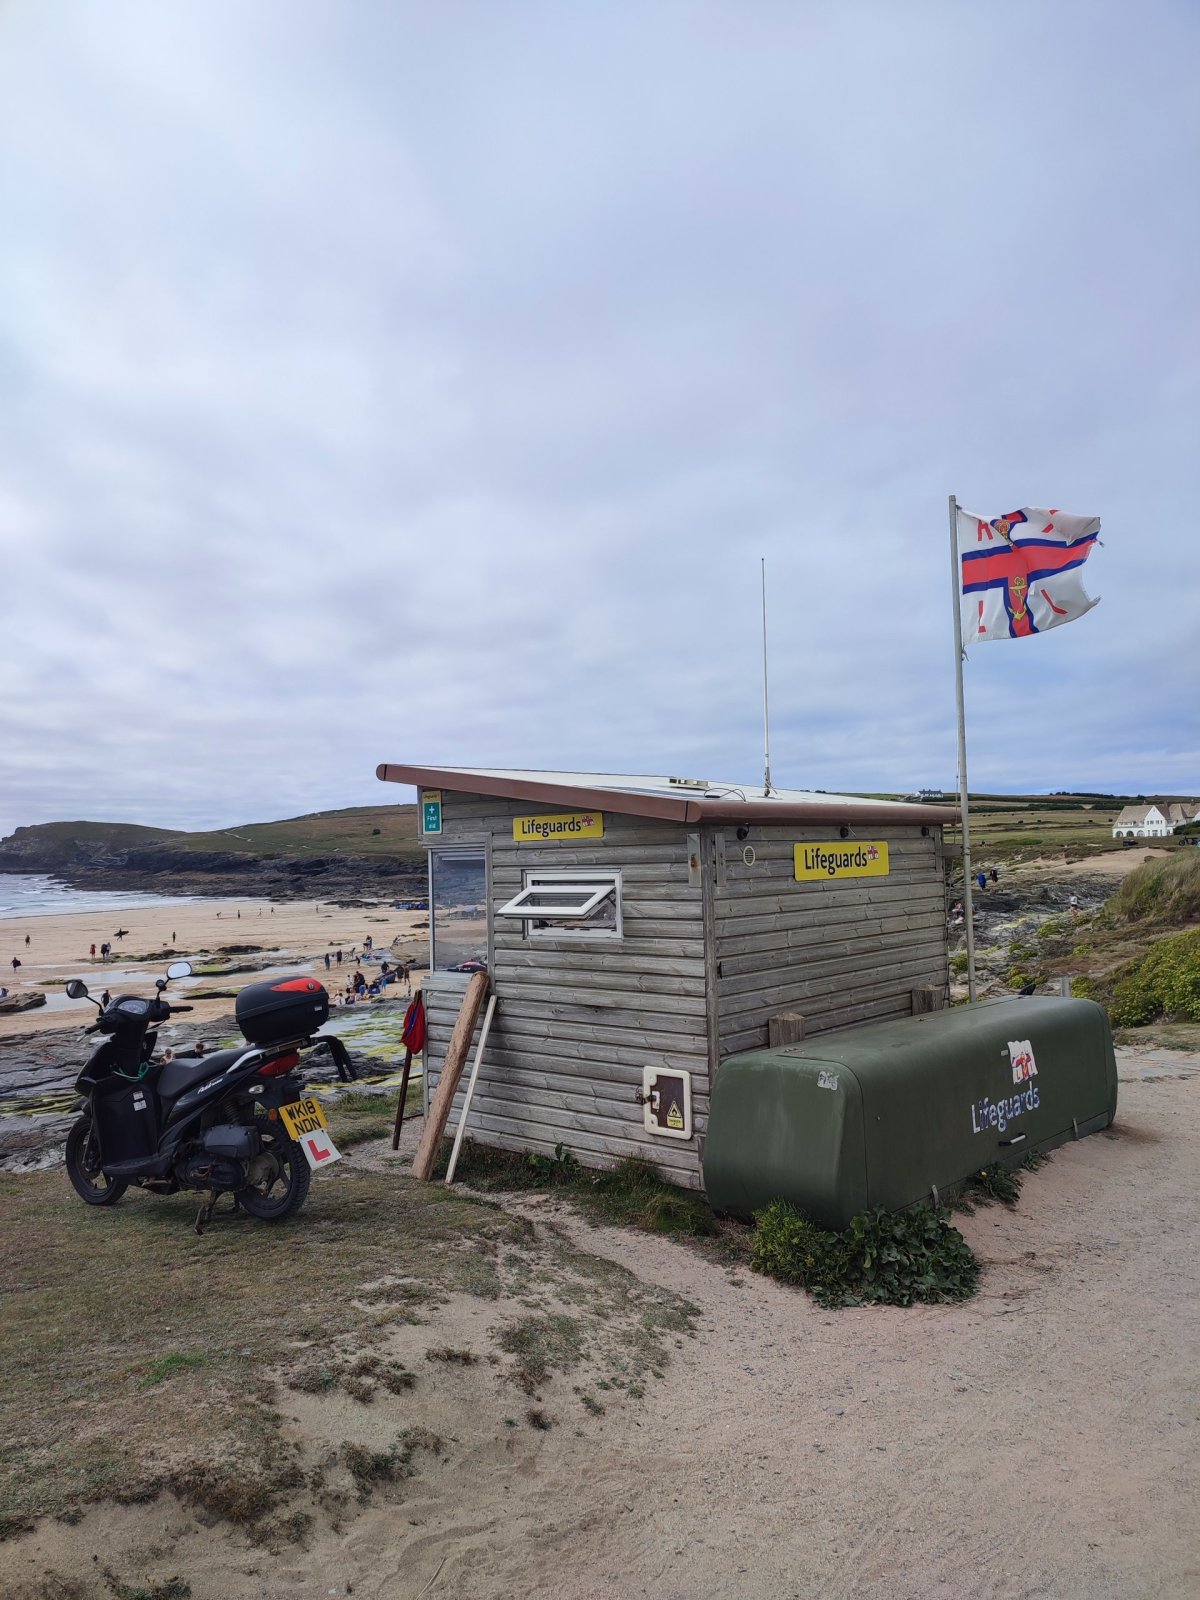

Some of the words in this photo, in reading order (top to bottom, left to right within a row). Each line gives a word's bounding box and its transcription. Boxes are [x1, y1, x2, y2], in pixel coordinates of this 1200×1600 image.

[521, 817, 582, 838] Lifeguards
[804, 846, 868, 876] Lifeguards
[285, 1101, 317, 1121] WK18
[971, 1080, 1040, 1134] Lifeguards
[293, 1116, 322, 1136] NDN
[307, 1139, 331, 1162] L
